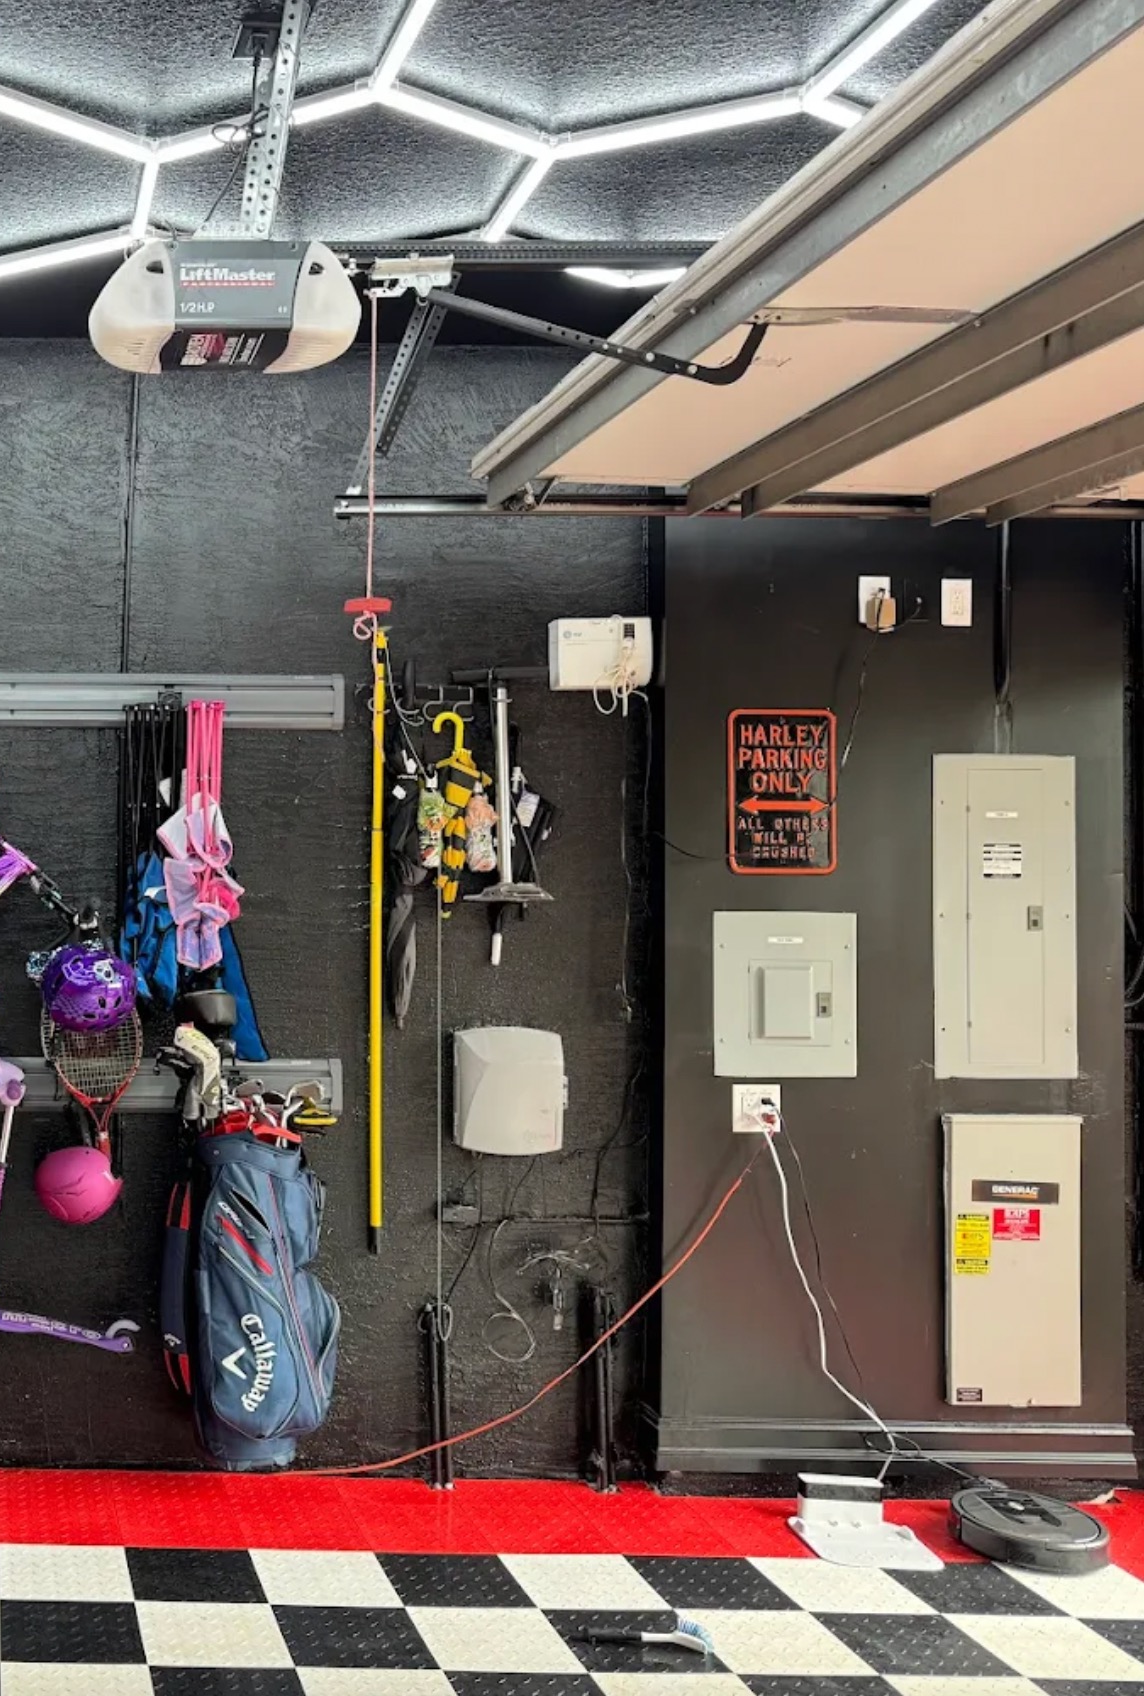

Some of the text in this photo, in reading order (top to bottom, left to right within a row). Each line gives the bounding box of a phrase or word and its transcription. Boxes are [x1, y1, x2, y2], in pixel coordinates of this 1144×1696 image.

[179, 267, 276, 281] LiftMaster
[739, 724, 825, 747] HARLEY
[738, 748, 828, 770] PARKING
[750, 771, 813, 793] ONLY
[738, 816, 829, 831] ALL OTHERS
[751, 831, 787, 845] WILL
[752, 846, 816, 860] CRUSHED
[991, 1184, 1040, 1195] GENERAC
[240, 1313, 277, 1413] Callaway
